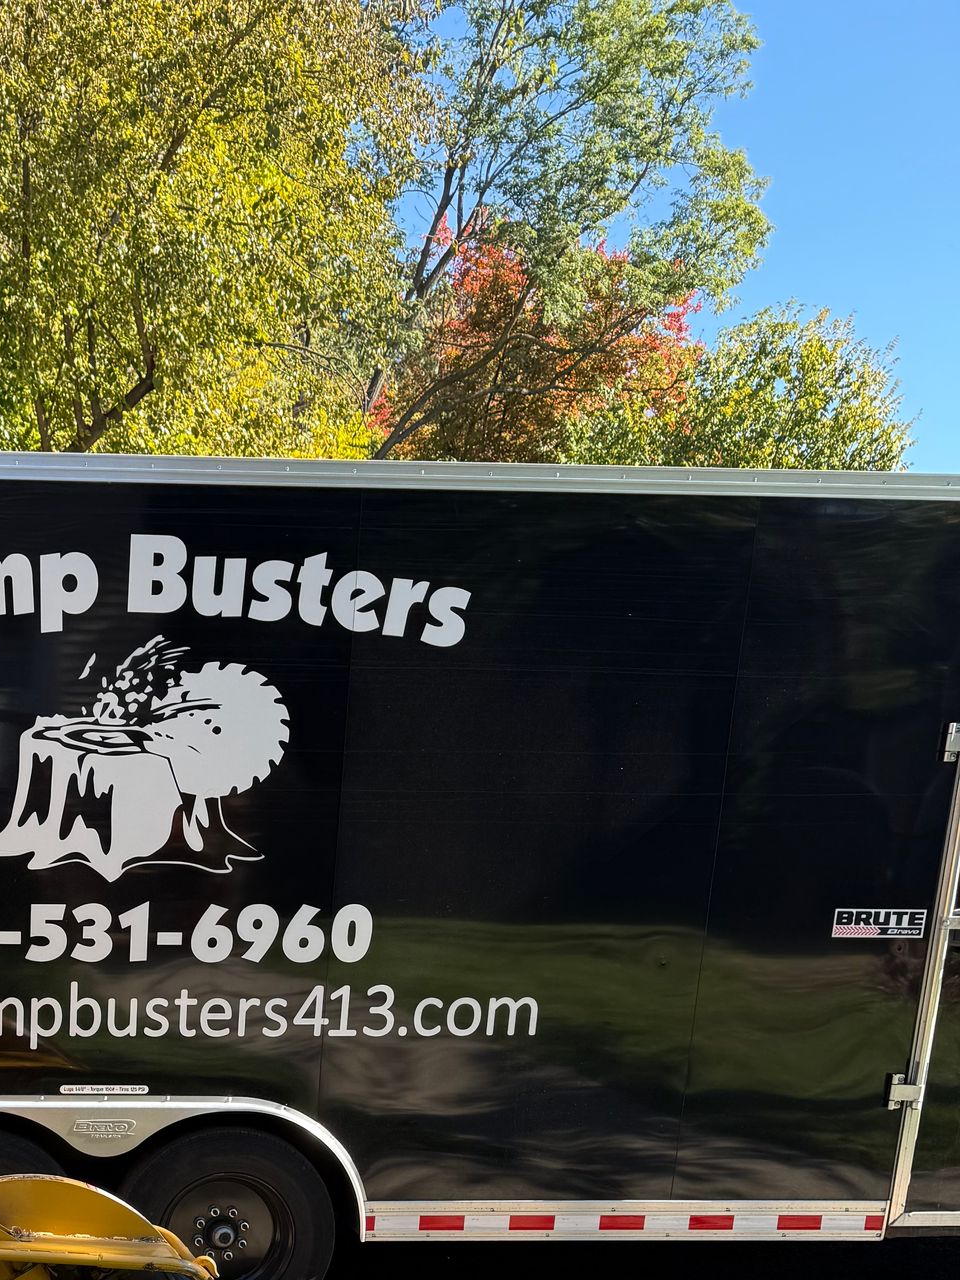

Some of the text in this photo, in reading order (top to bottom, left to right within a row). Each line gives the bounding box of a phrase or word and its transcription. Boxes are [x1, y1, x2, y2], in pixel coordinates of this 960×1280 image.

[127, 534, 472, 648] Busters
[836, 911, 925, 926] BRUTE
[73, 1120, 128, 1132] Bravo
